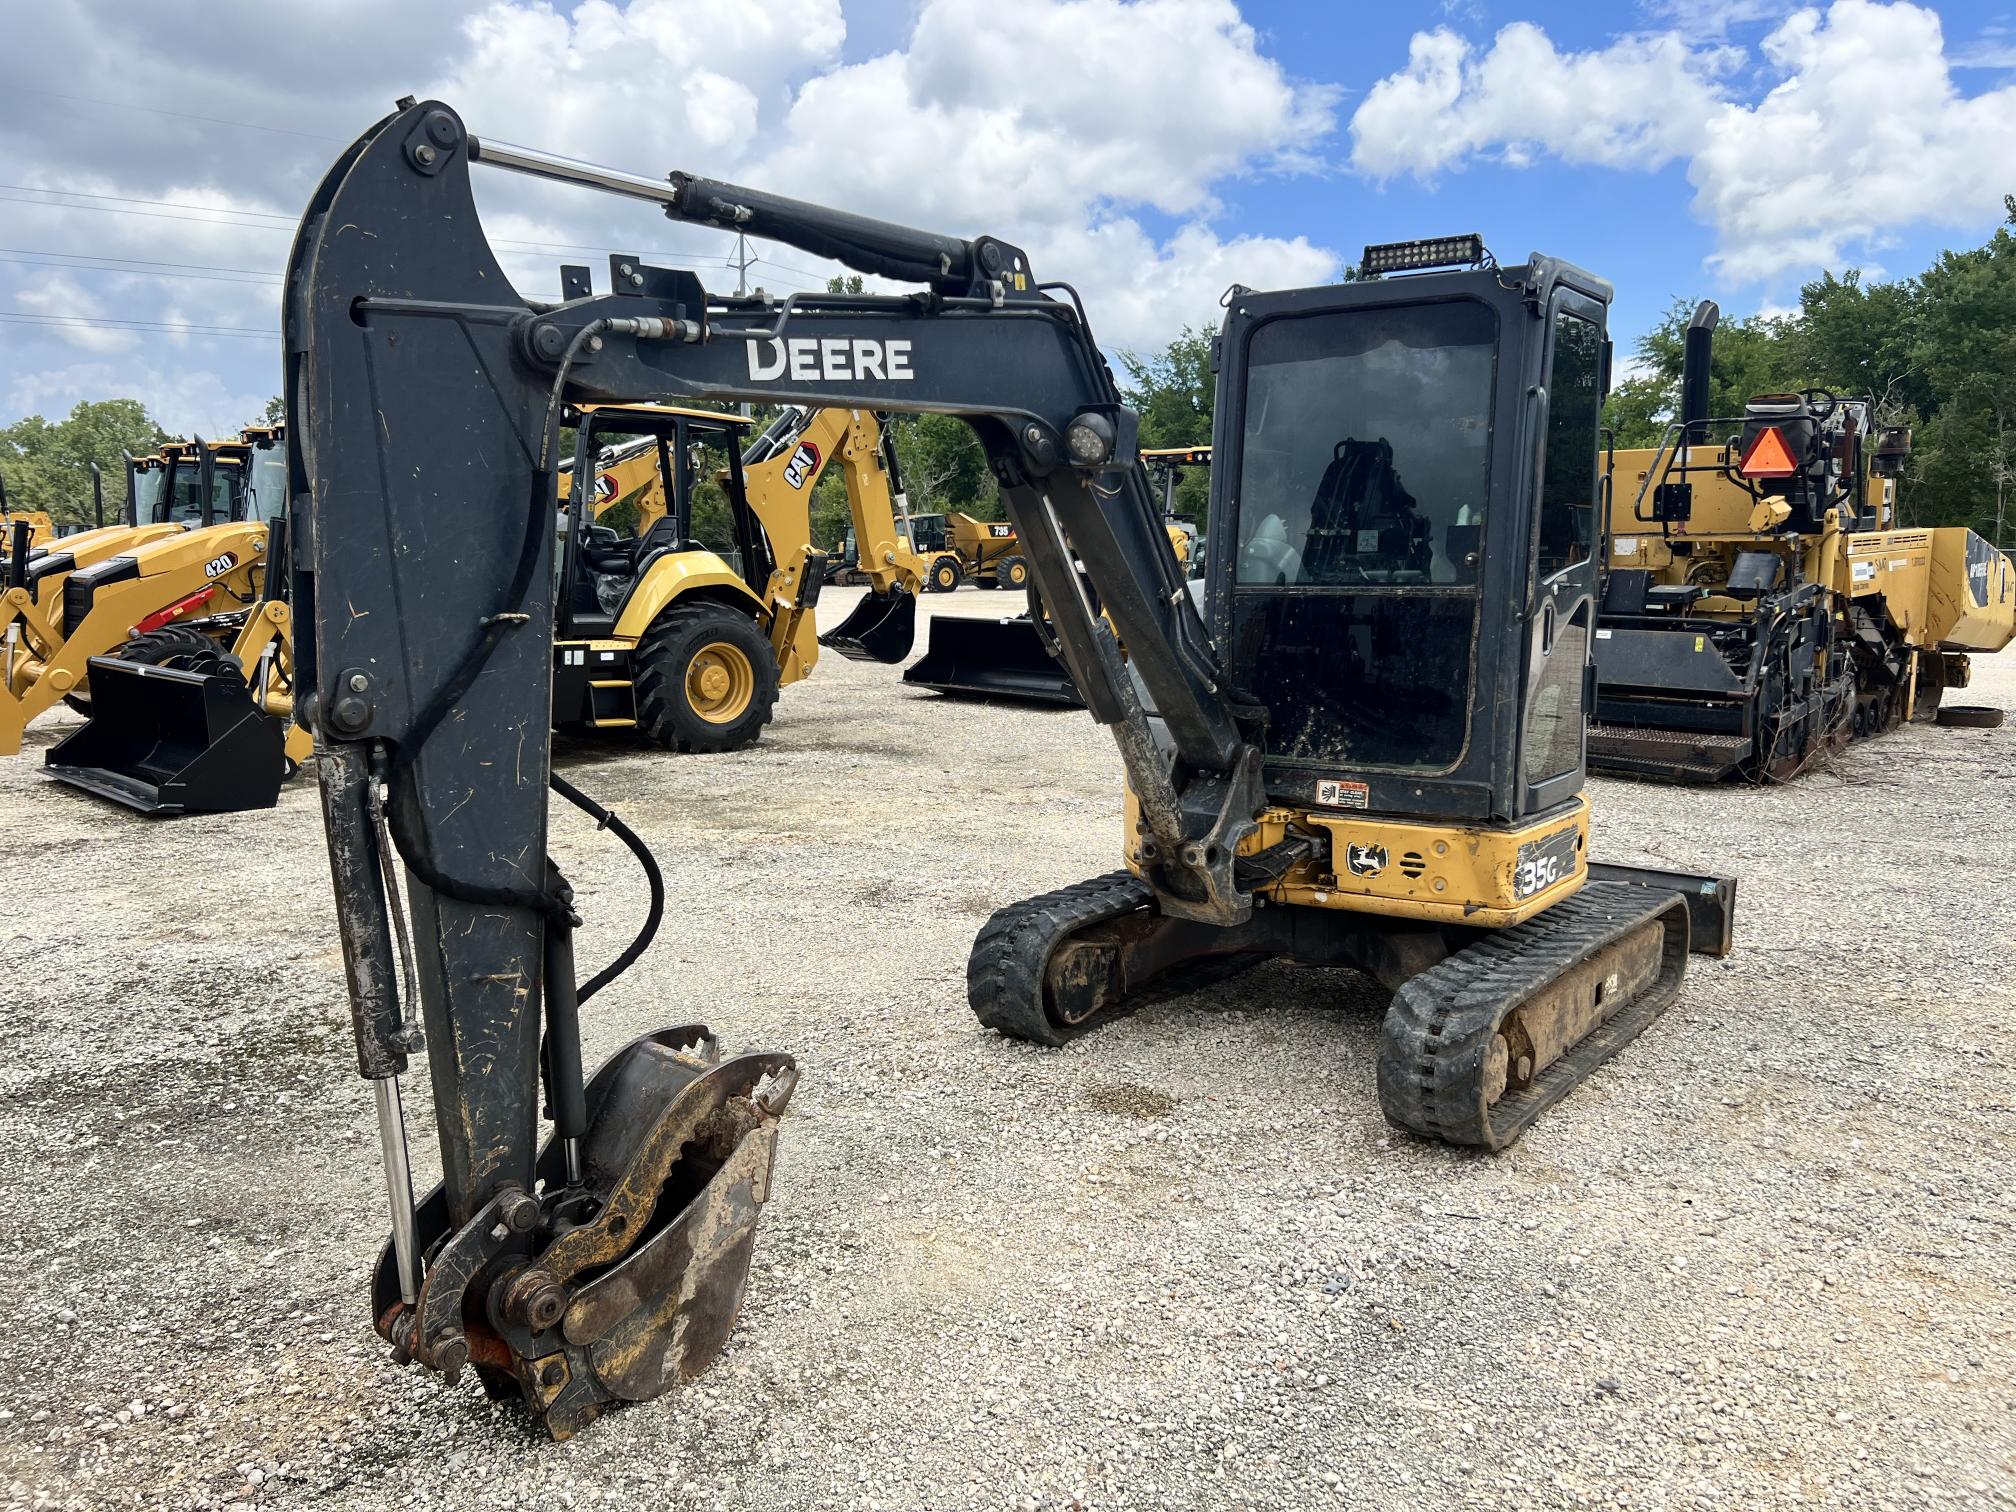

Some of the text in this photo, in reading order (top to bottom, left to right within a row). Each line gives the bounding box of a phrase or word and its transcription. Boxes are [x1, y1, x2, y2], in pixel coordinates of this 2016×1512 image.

[746, 336, 914, 381] DEERE
[784, 445, 814, 489] CAT
[994, 526, 1008, 536] 735
[205, 555, 233, 577] 420
[1520, 855, 1557, 895] 35G
